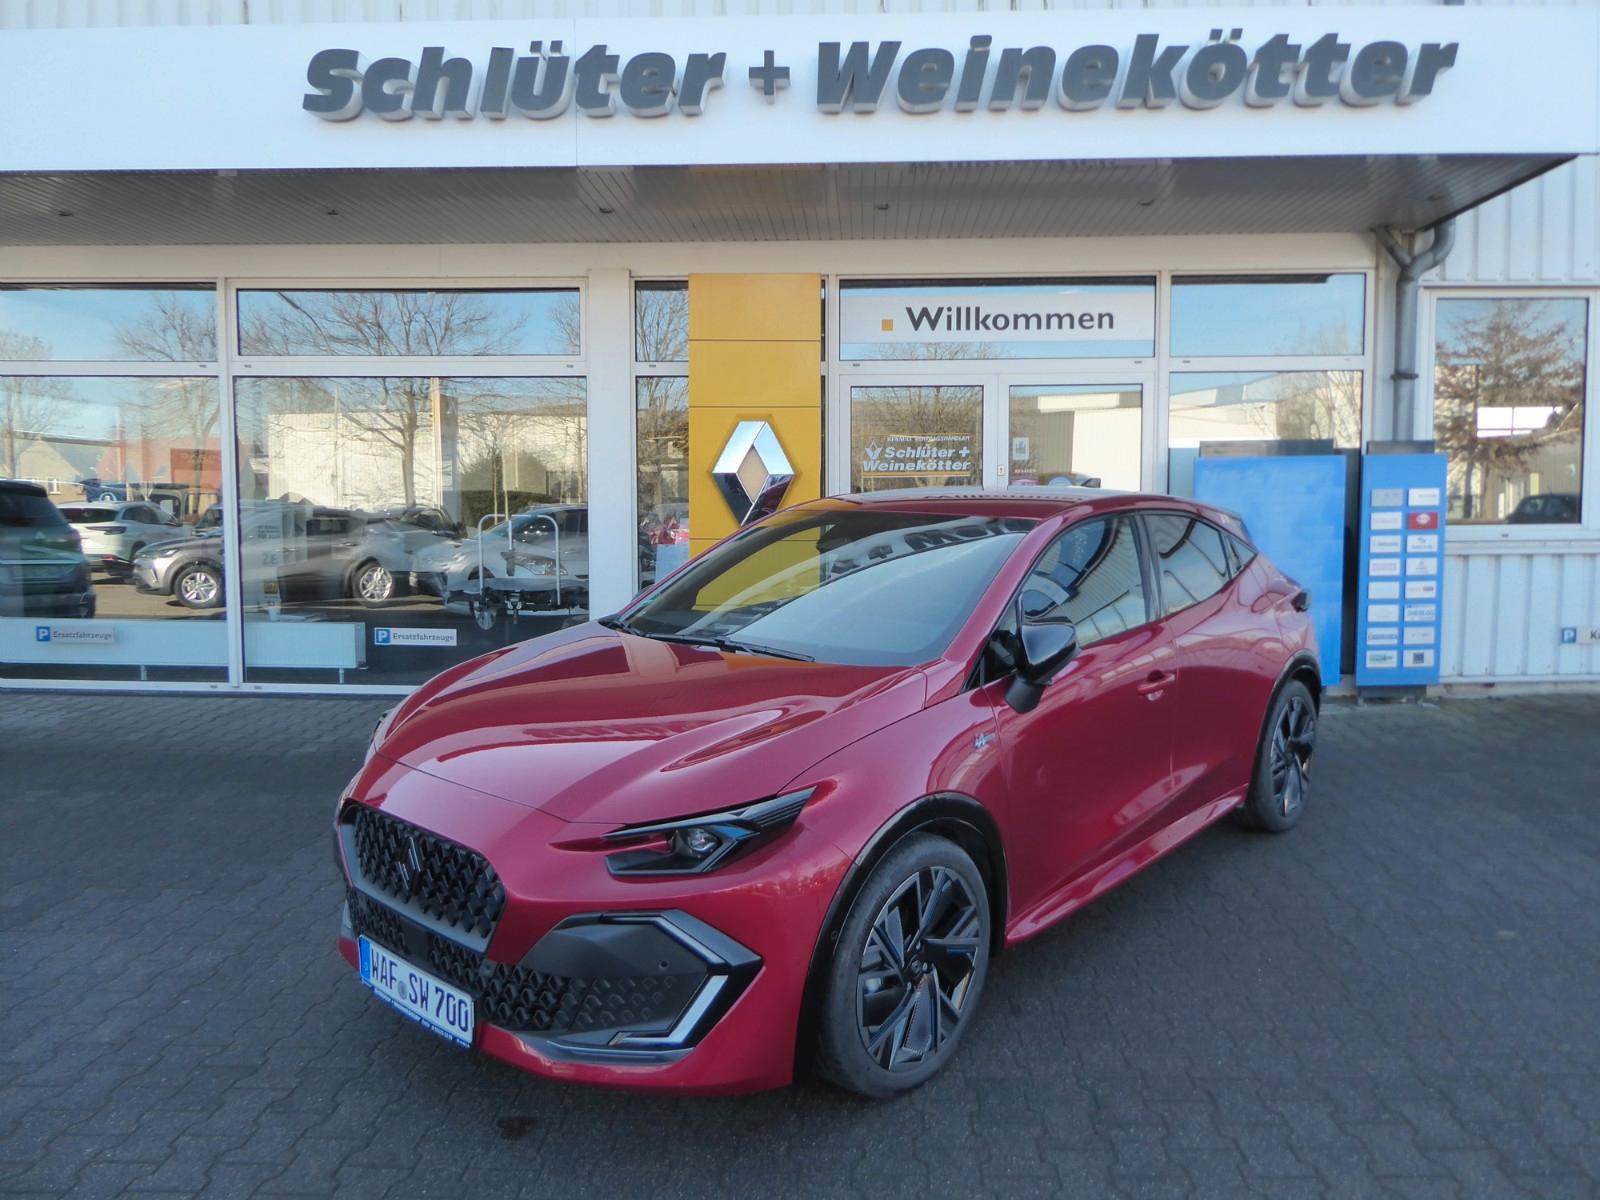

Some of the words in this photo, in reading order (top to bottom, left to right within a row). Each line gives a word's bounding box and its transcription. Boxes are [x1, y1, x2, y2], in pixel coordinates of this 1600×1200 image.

[303, 39, 727, 121] Schlüter
[748, 50, 791, 104] +
[813, 28, 1460, 113] Weinekötter
[906, 306, 1114, 332] Willkommen
[885, 444, 955, 459] Schlüter
[959, 446, 970, 458] +
[863, 460, 971, 472] Weinekötter
[53, 631, 112, 641] Ersatzfahrzeuge
[393, 632, 454, 643] Ersatzfahrzeuge
[371, 948, 398, 990] WAF
[408, 971, 430, 1012] SW
[435, 986, 470, 1033] 700
